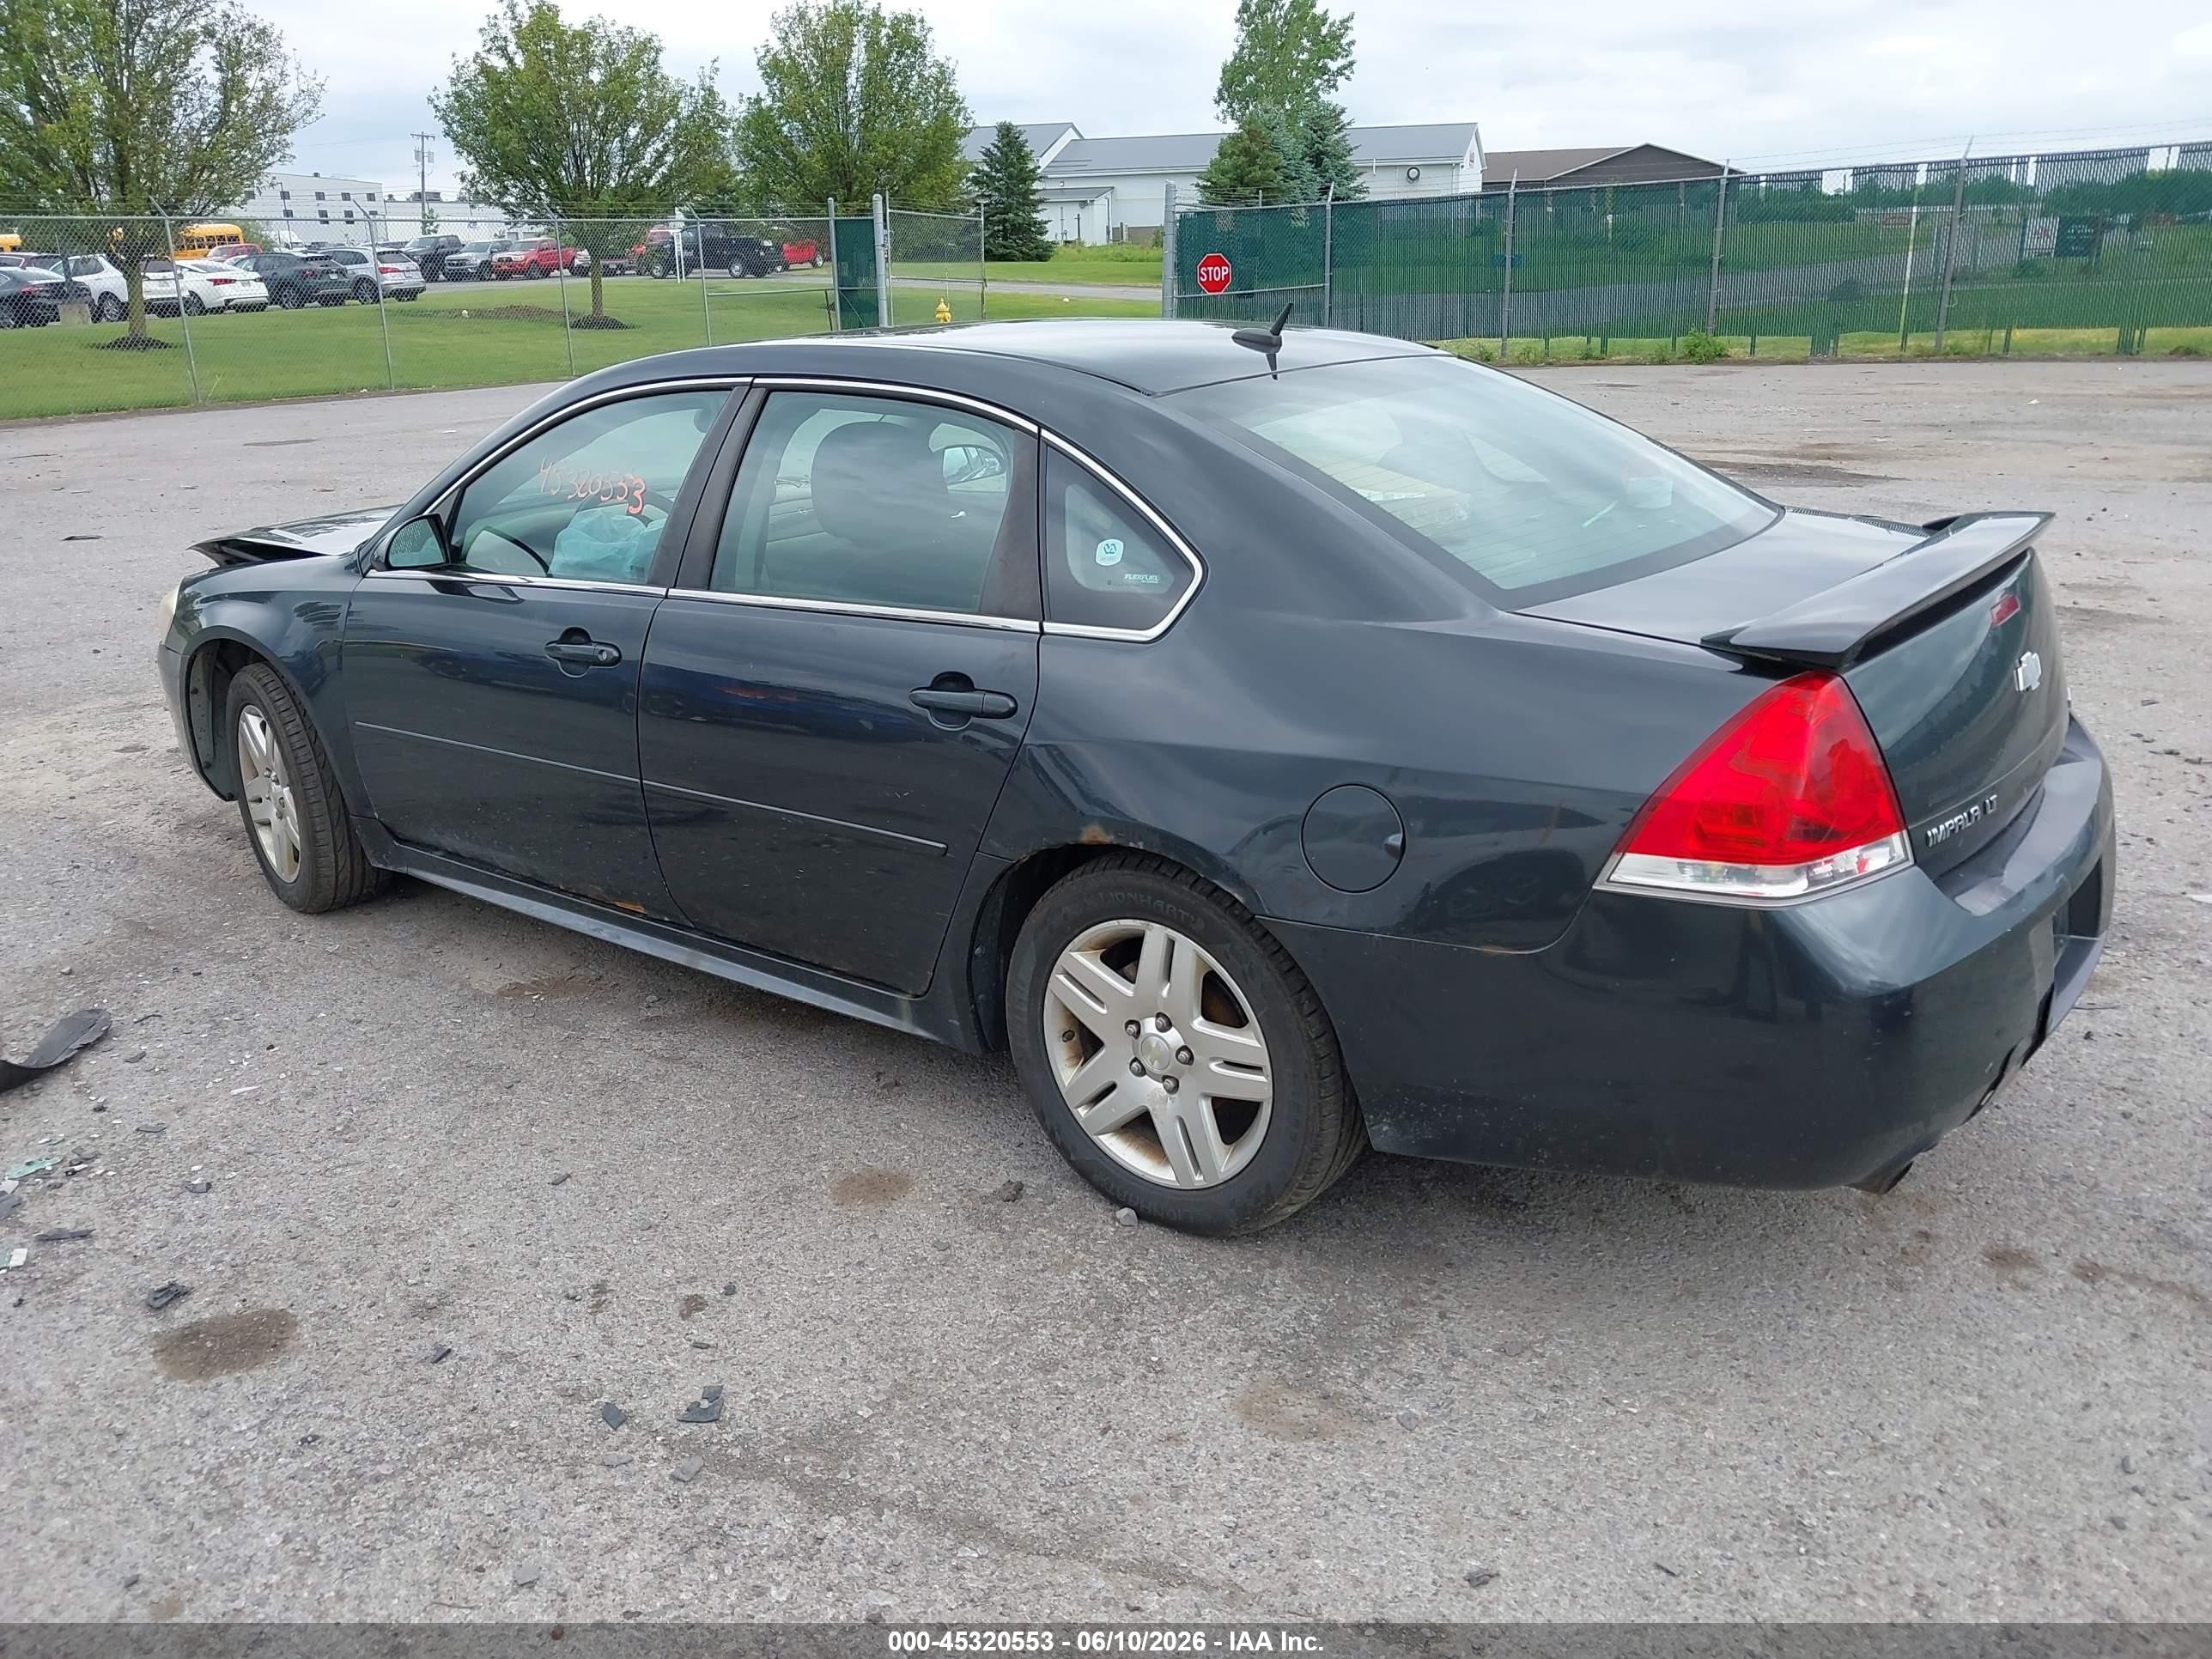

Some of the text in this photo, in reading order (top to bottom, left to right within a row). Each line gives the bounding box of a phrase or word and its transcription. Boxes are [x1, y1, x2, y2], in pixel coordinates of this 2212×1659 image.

[1200, 266, 1229, 282] STOP
[1926, 794, 1998, 848] IMPALA LT
